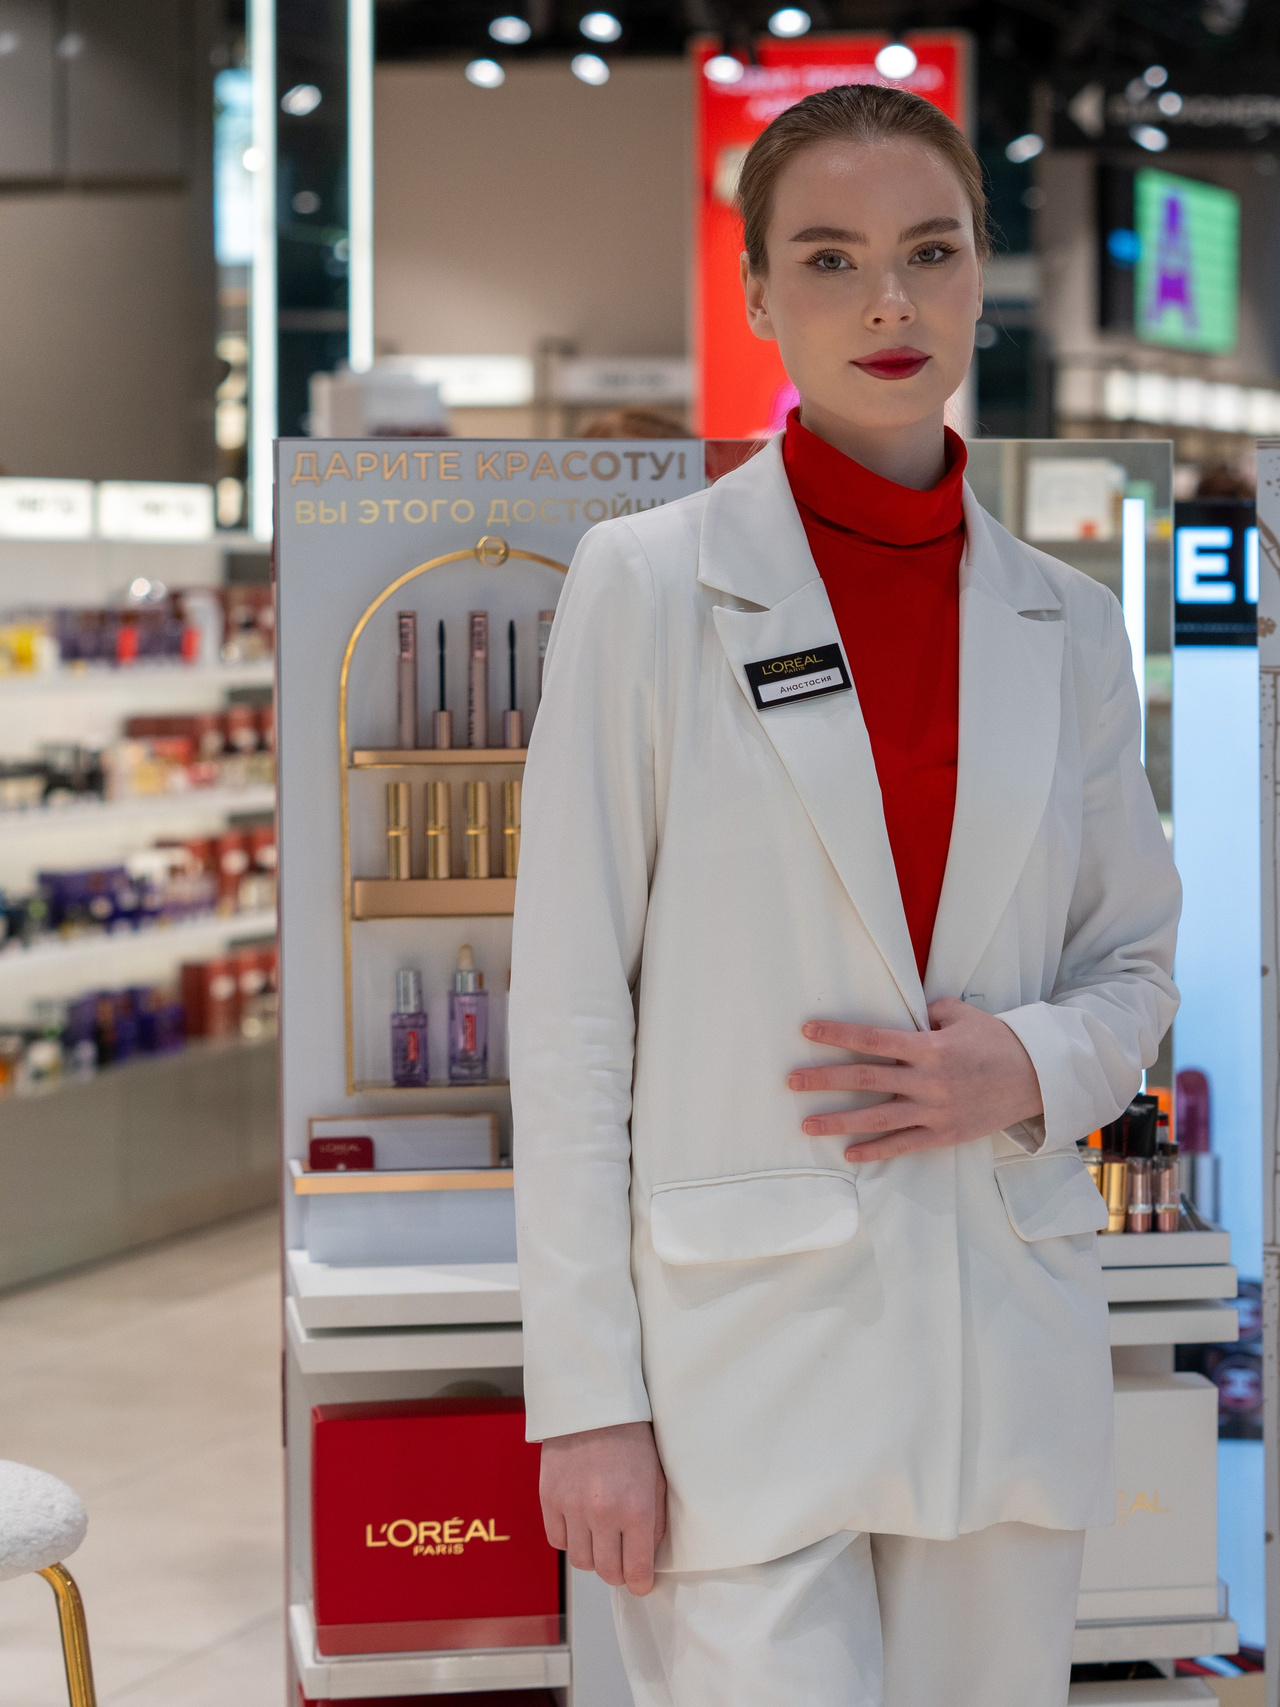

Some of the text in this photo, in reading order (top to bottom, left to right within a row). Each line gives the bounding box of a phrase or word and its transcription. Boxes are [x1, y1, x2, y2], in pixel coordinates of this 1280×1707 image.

[291, 451, 686, 487] ДАРИТЕ КРАСОТУ!
[295, 493, 668, 527] ВЫ ЭТОГО ДОСТОЙН
[761, 654, 823, 675] L'ORÉAL
[780, 675, 832, 694] Анастасия
[366, 1517, 511, 1548] L'ORÉAL
